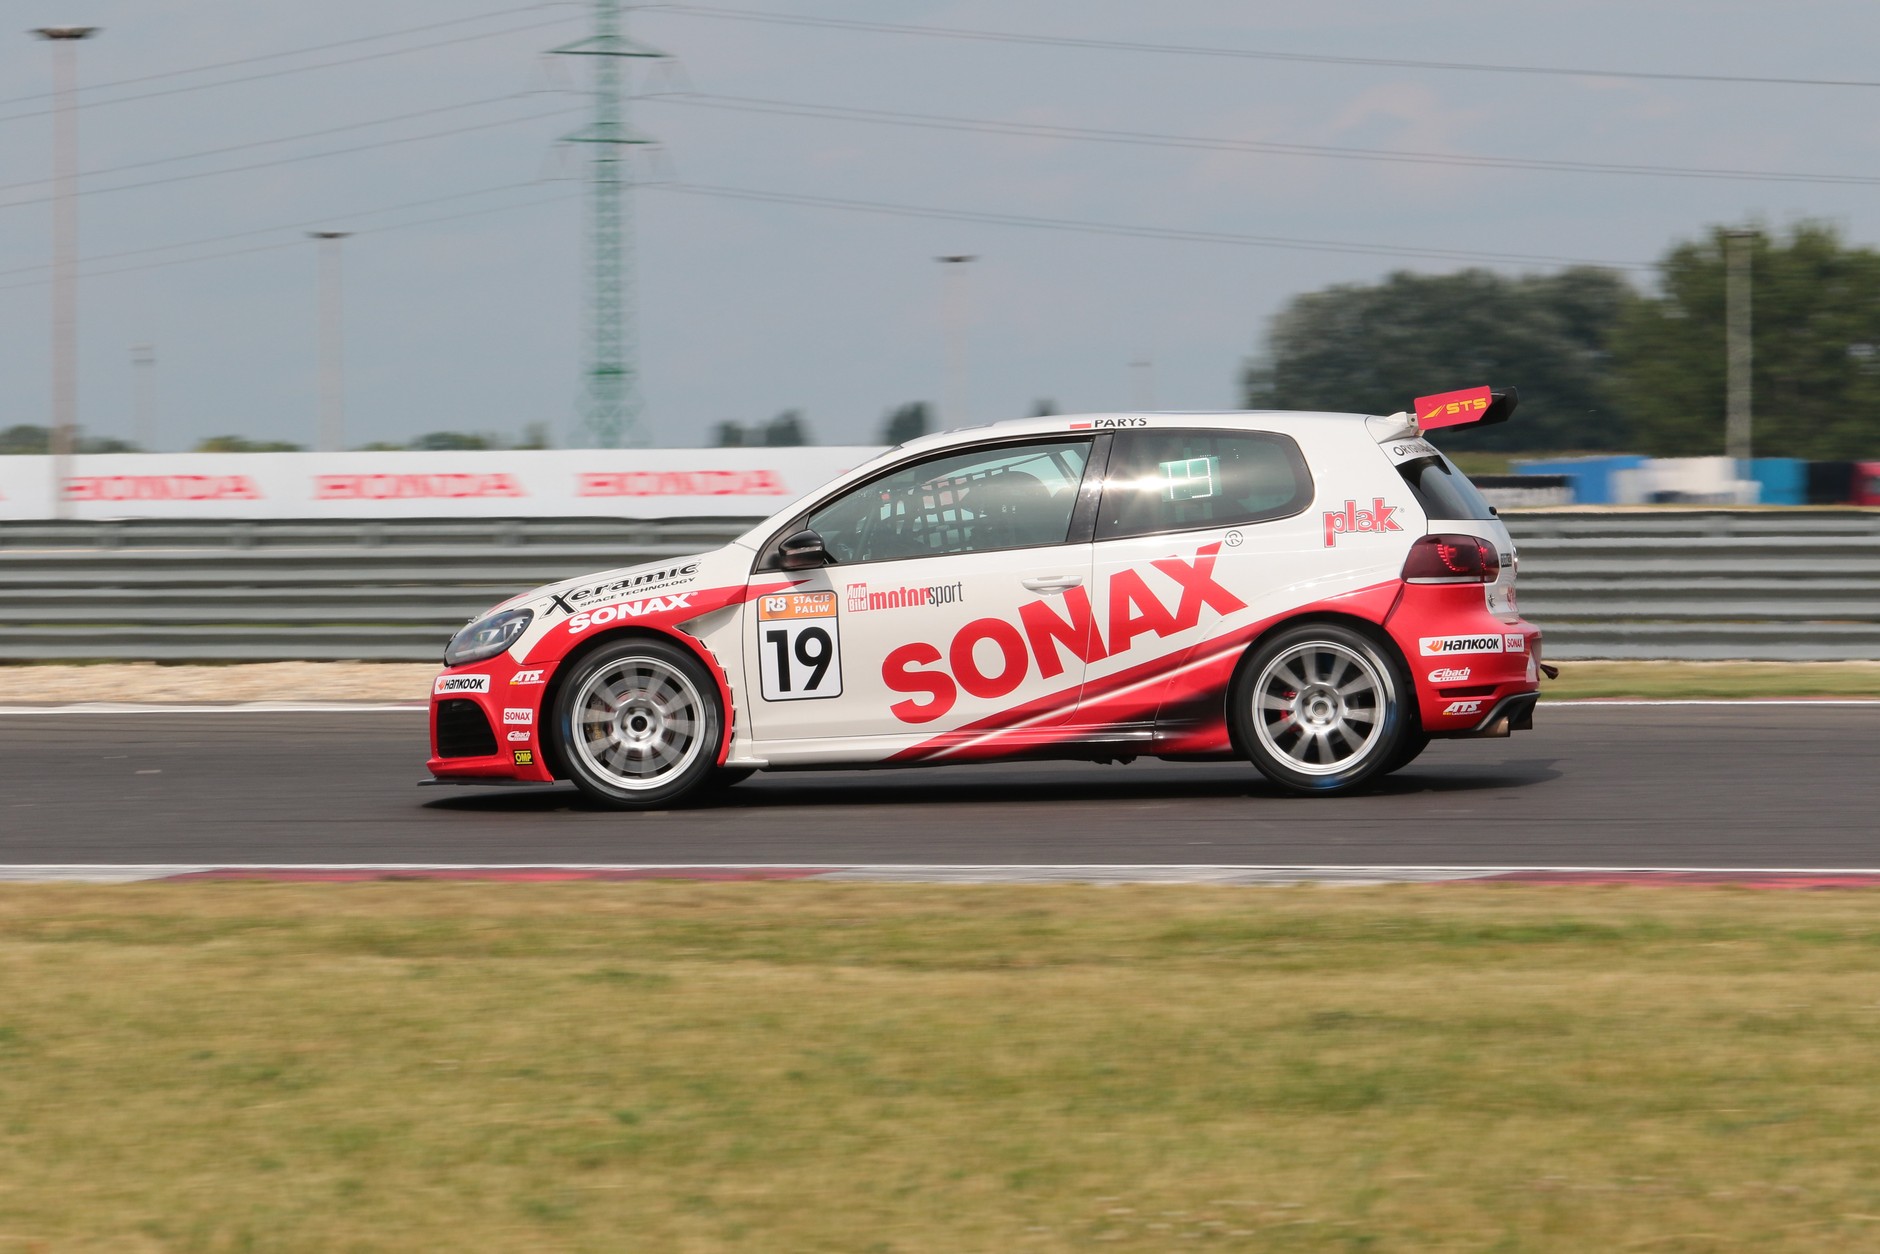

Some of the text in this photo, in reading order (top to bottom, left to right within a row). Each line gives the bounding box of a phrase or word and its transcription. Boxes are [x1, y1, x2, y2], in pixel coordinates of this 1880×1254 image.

[1446, 397, 1487, 415] STS
[1094, 417, 1147, 428] PARYS
[1322, 497, 1404, 548] plak
[542, 562, 700, 618] Xeramic
[579, 577, 696, 608] SPACE TECHNOLOGY
[793, 593, 831, 605] STACJE
[568, 592, 692, 635] SONAX
[794, 603, 830, 615] PALIW
[881, 541, 1249, 724] SONAX
[1506, 638, 1523, 648] SONAX
[766, 626, 834, 693] 19
[1427, 667, 1471, 683] Eibach
[504, 711, 531, 721] SONAX
[515, 752, 532, 762] OMP
